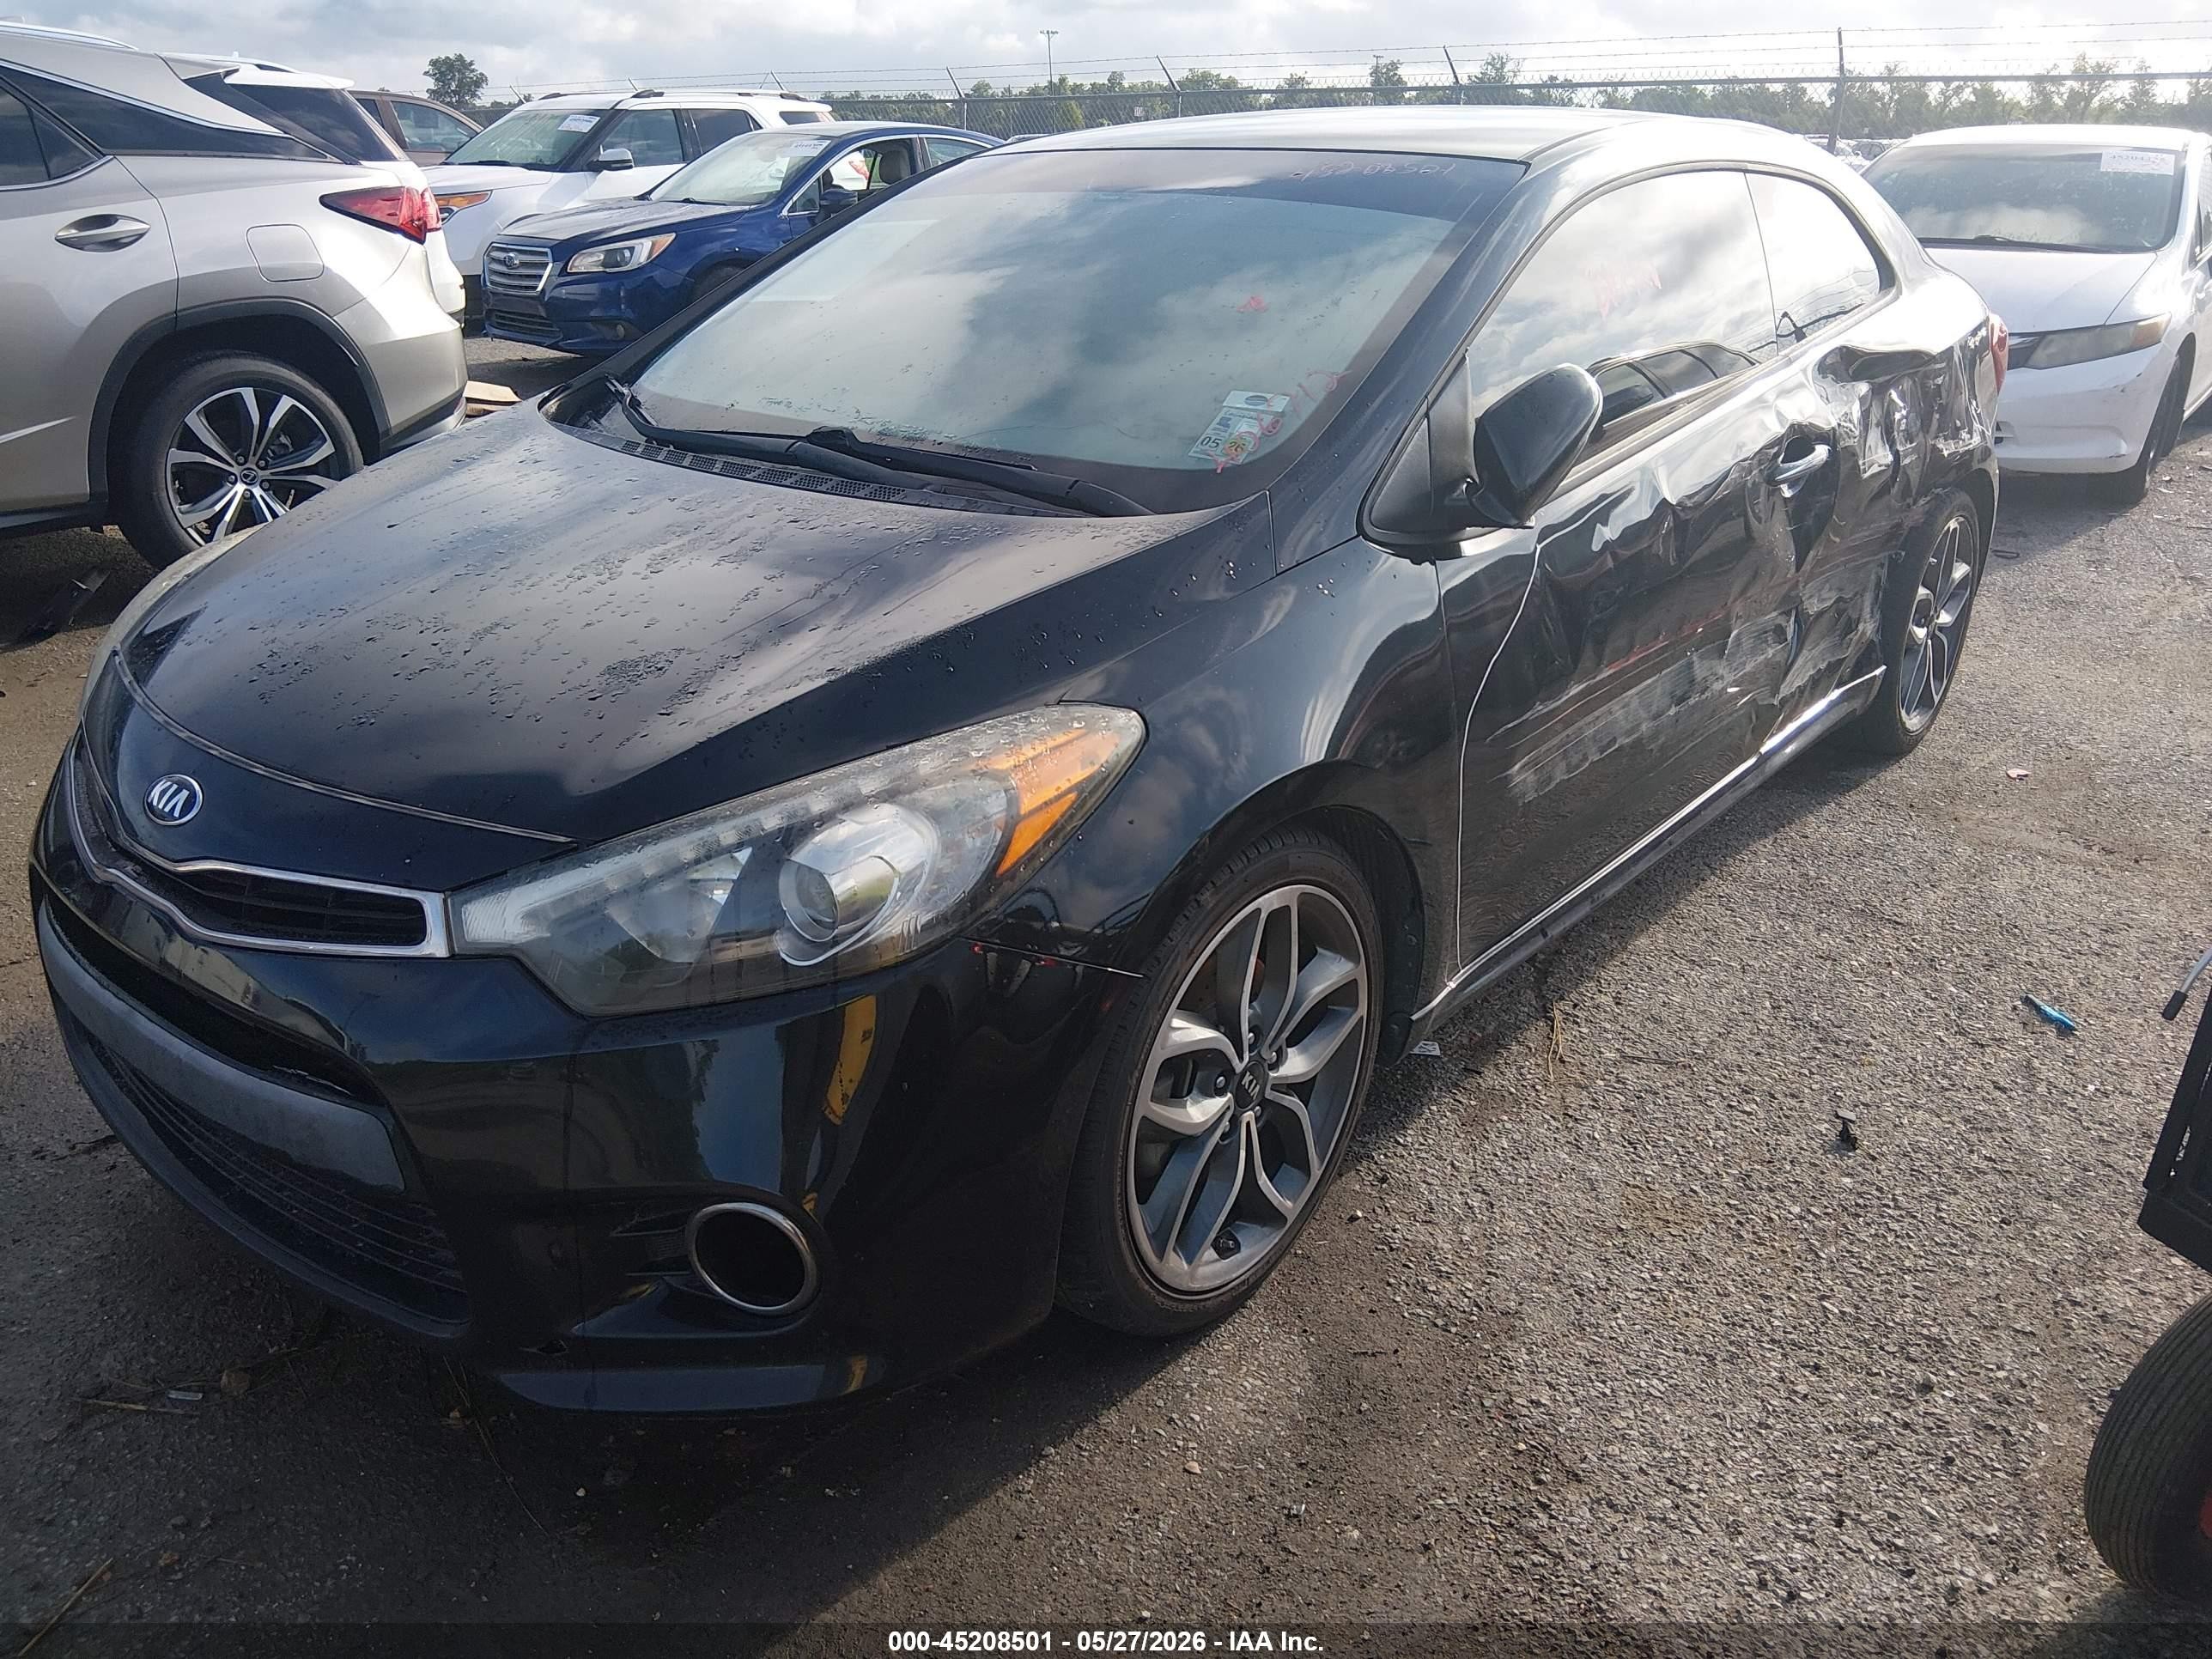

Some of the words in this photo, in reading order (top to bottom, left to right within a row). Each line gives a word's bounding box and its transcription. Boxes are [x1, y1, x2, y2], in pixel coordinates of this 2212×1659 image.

[1200, 435, 1223, 449] 05
[147, 778, 191, 818] KIA
[1241, 1070, 1261, 1100] KIA
